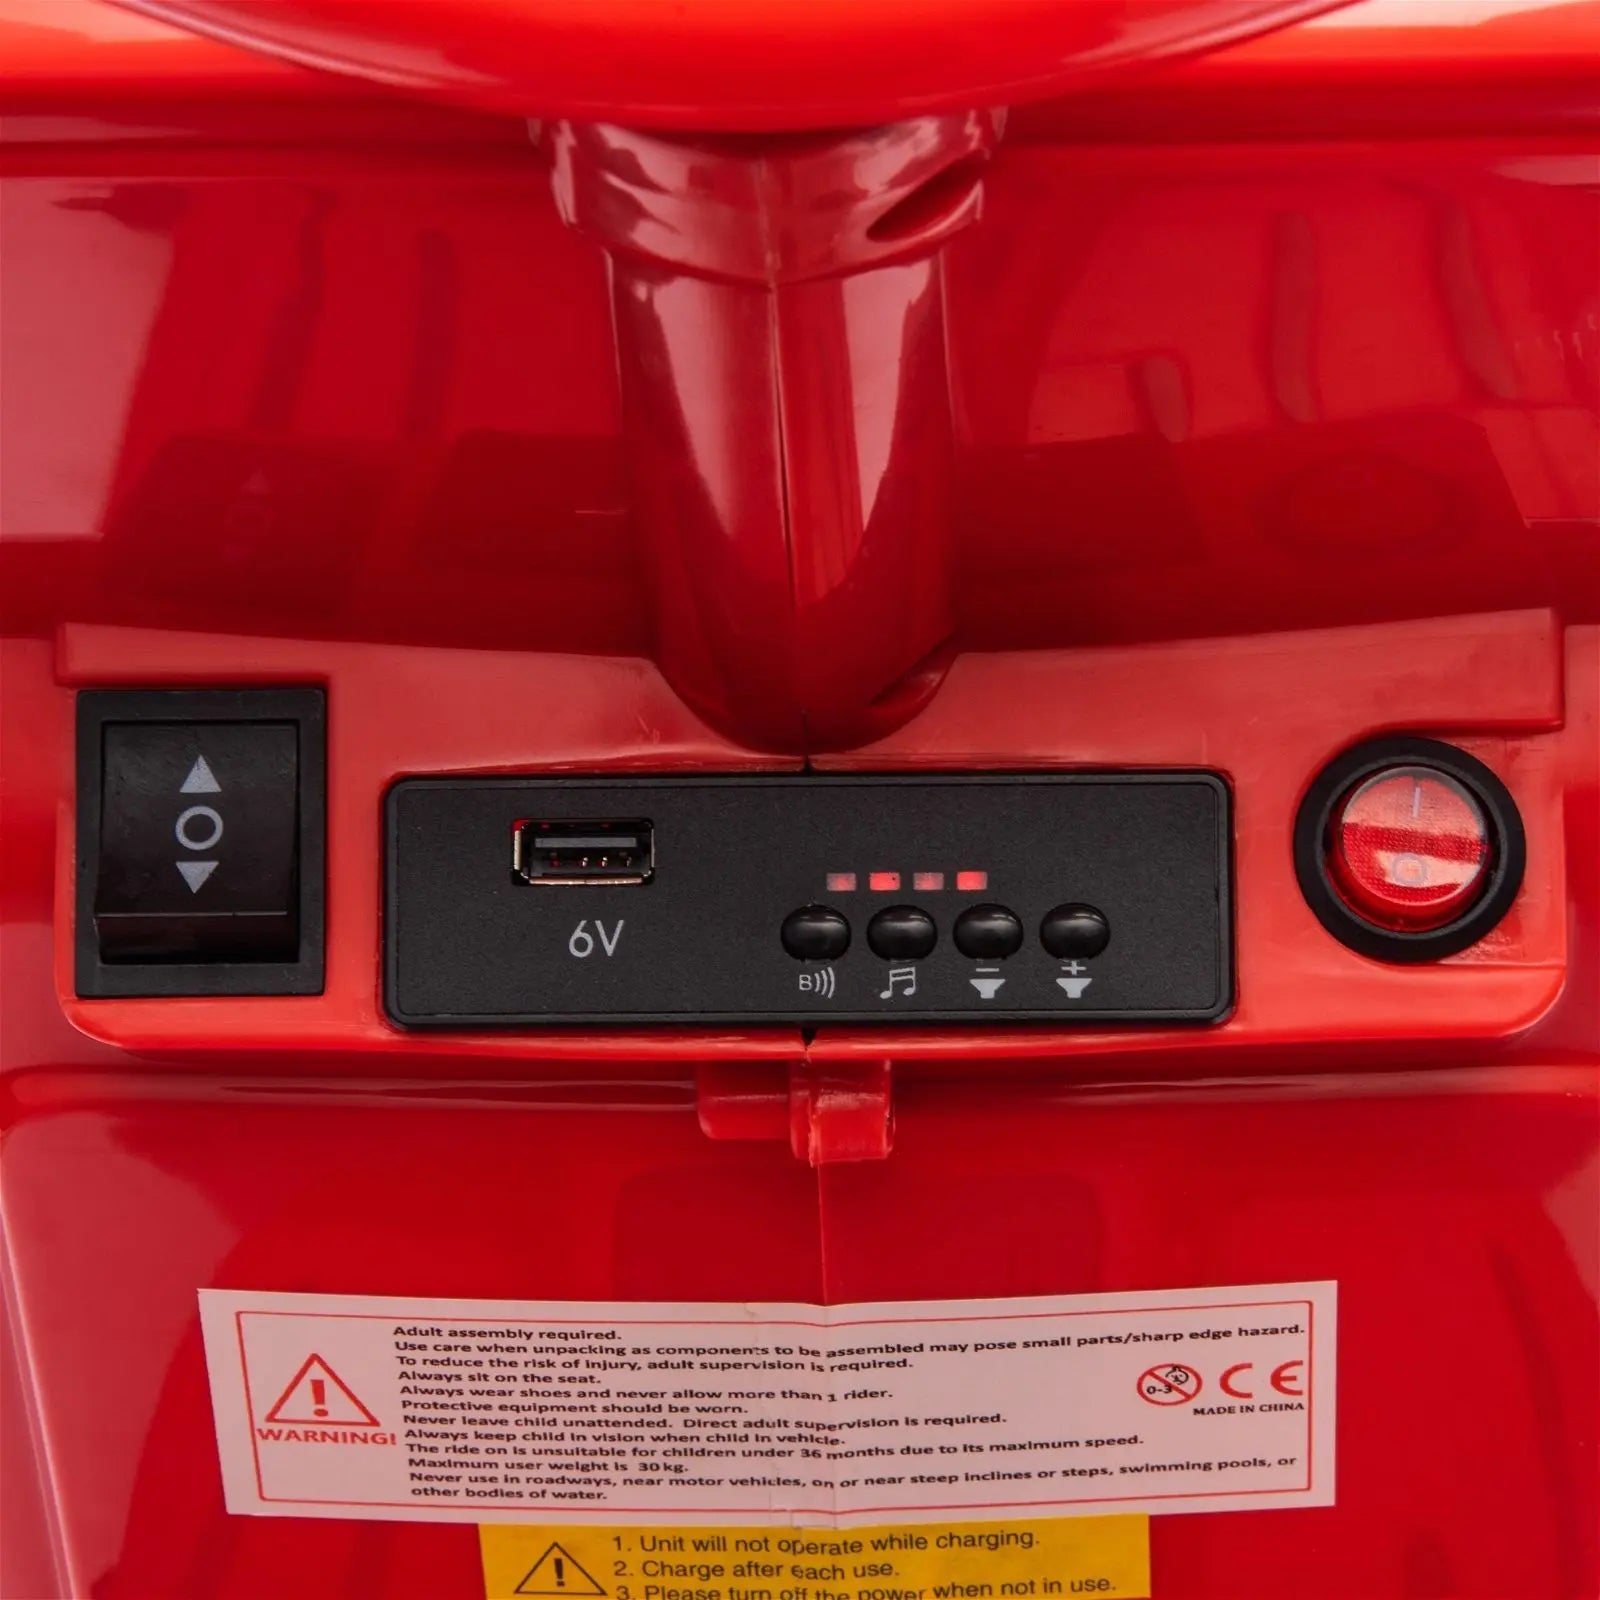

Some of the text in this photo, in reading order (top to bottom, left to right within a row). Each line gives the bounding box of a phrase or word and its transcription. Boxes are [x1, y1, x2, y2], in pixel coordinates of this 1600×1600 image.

[568, 919, 625, 958] 6V
[393, 1326, 622, 1341] Adult assembly required.
[394, 1324, 1305, 1359] Use care when unpacking as components to be assembled may pose small parts/sharp edge hazard.
[396, 1356, 913, 1372] To reduce the risk of injury, adult supervision is required.
[398, 1370, 601, 1384] Always sit on the seat.
[400, 1385, 464, 1398] Always
[469, 1389, 515, 1397] wear
[520, 1388, 572, 1398] shoes
[577, 1389, 611, 1398] and
[672, 1389, 723, 1399] allow
[780, 1389, 822, 1401] than
[827, 1393, 837, 1402] 1
[844, 1389, 893, 1400] rider.
[401, 1400, 493, 1411] Protective
[498, 1403, 597, 1414] equipment
[601, 1403, 663, 1413] should
[668, 1404, 690, 1413] be
[1193, 1403, 1304, 1415] MADE IN CHINA
[403, 1413, 1006, 1432] Never leave child unattended. Direct adult supervision is required.
[257, 1428, 397, 1446] WARNING!
[404, 1429, 845, 1446] Always keep child in vision when child in vehicle.
[405, 1435, 1144, 1460] The ride on is unsuitable for children under 36 months due to its maximum speed.
[408, 1458, 499, 1469] Maximum
[505, 1462, 544, 1470] user
[548, 1461, 609, 1473] weight
[614, 1462, 628, 1471] is
[409, 1472, 463, 1482] Never
[504, 1474, 520, 1484] in
[525, 1475, 617, 1487] roadways,
[623, 1478, 664, 1486] near
[669, 1477, 724, 1486] motor
[729, 1477, 806, 1487] vehicles,
[812, 1479, 834, 1489] on
[840, 1479, 859, 1488] or
[864, 1477, 905, 1485] near
[910, 1475, 959, 1484] steep
[964, 1471, 1032, 1482] inclines
[1061, 1468, 1113, 1478] steps,
[1119, 1461, 1213, 1474] swimming
[1218, 1458, 1271, 1471] pools,
[411, 1486, 607, 1500] other bodies of water.
[613, 1530, 1039, 1556] 1. Unit will not operate while charging.
[614, 1560, 899, 1582] 2. Charge after each use.
[645, 1585, 721, 1600] Please
[728, 1587, 782, 1600] turn
[784, 1587, 808, 1600] off
[815, 1589, 850, 1600] the
[857, 1589, 926, 1600] power
[932, 1583, 993, 1599] when
[1001, 1580, 1036, 1595] not
[1043, 1578, 1062, 1593] in
[1070, 1578, 1116, 1592] use.
